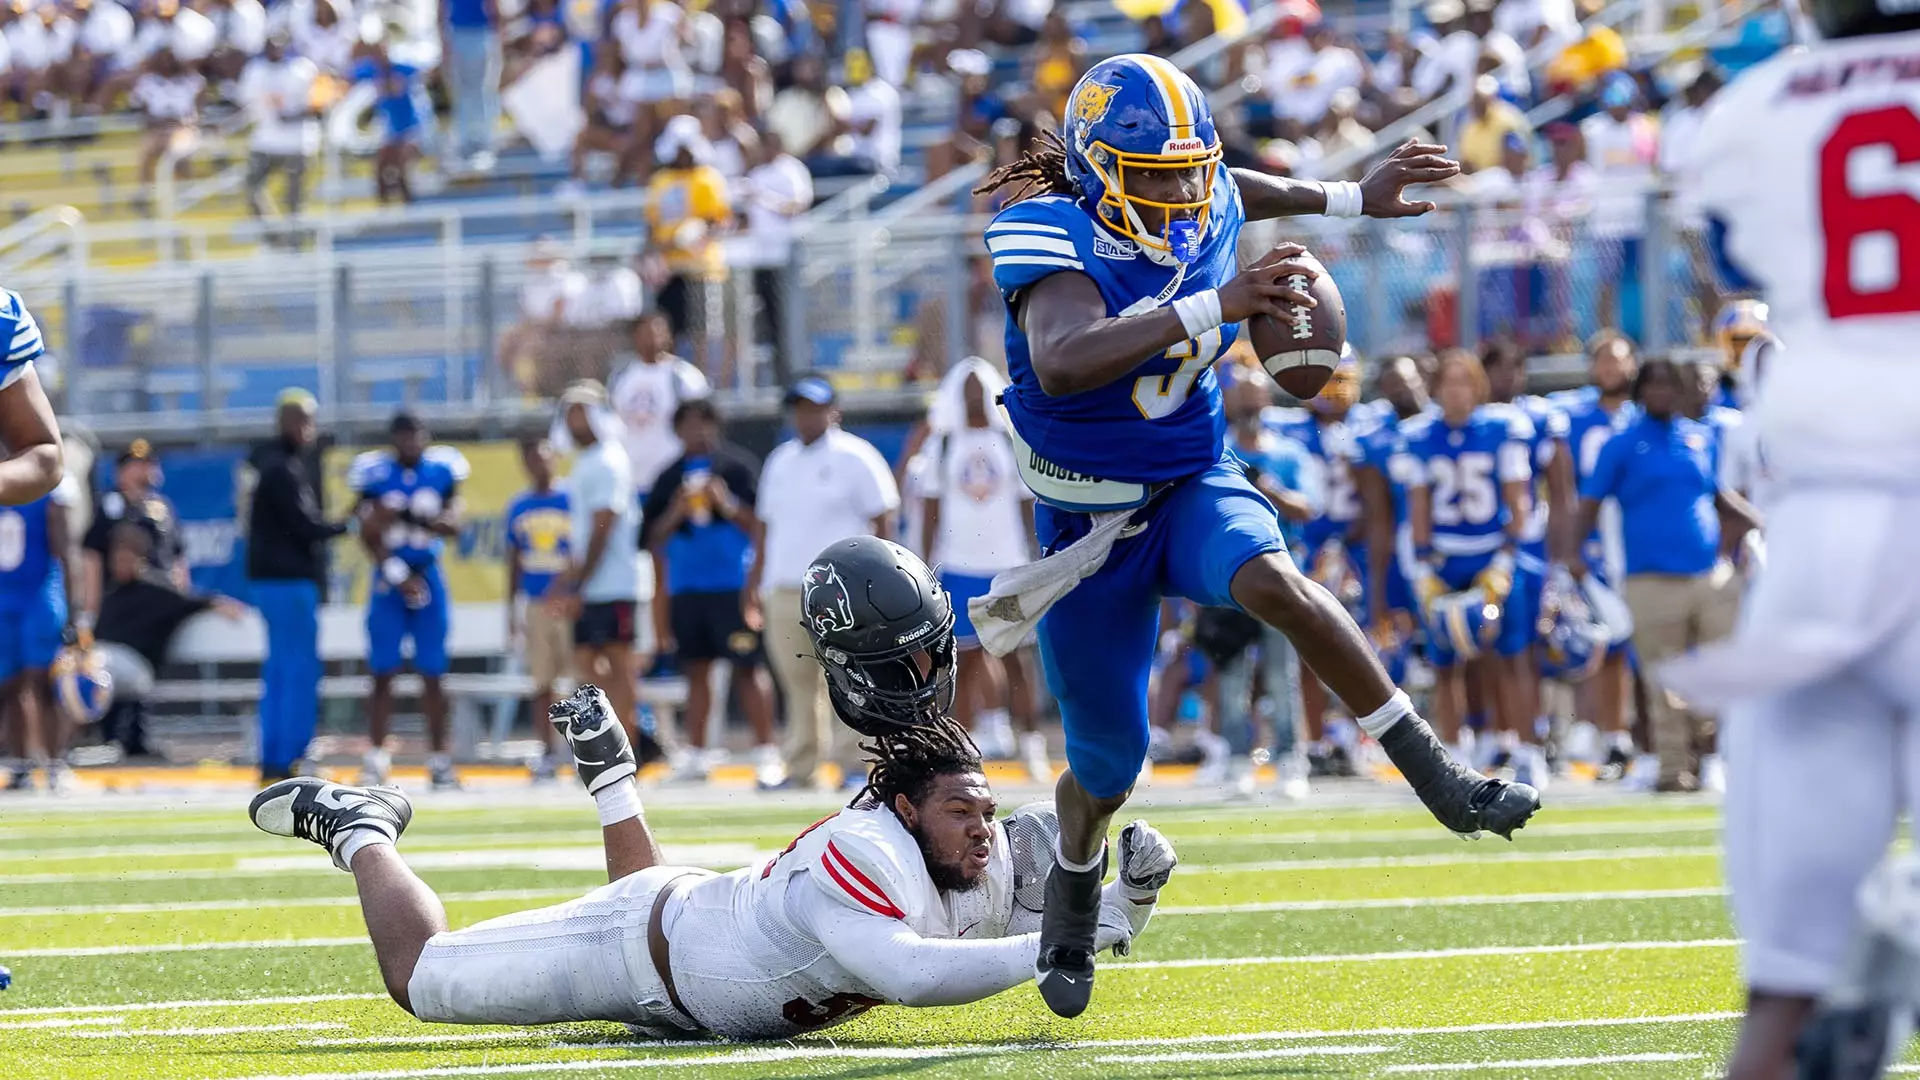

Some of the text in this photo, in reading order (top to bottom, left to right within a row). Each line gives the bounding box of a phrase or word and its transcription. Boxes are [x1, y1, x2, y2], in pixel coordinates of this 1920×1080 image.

[1168, 141, 1201, 151] Riddell
[1821, 104, 1920, 319] 6
[1131, 325, 1222, 420] 3
[1029, 448, 1104, 484] DOUGL
[1427, 451, 1499, 527] 25
